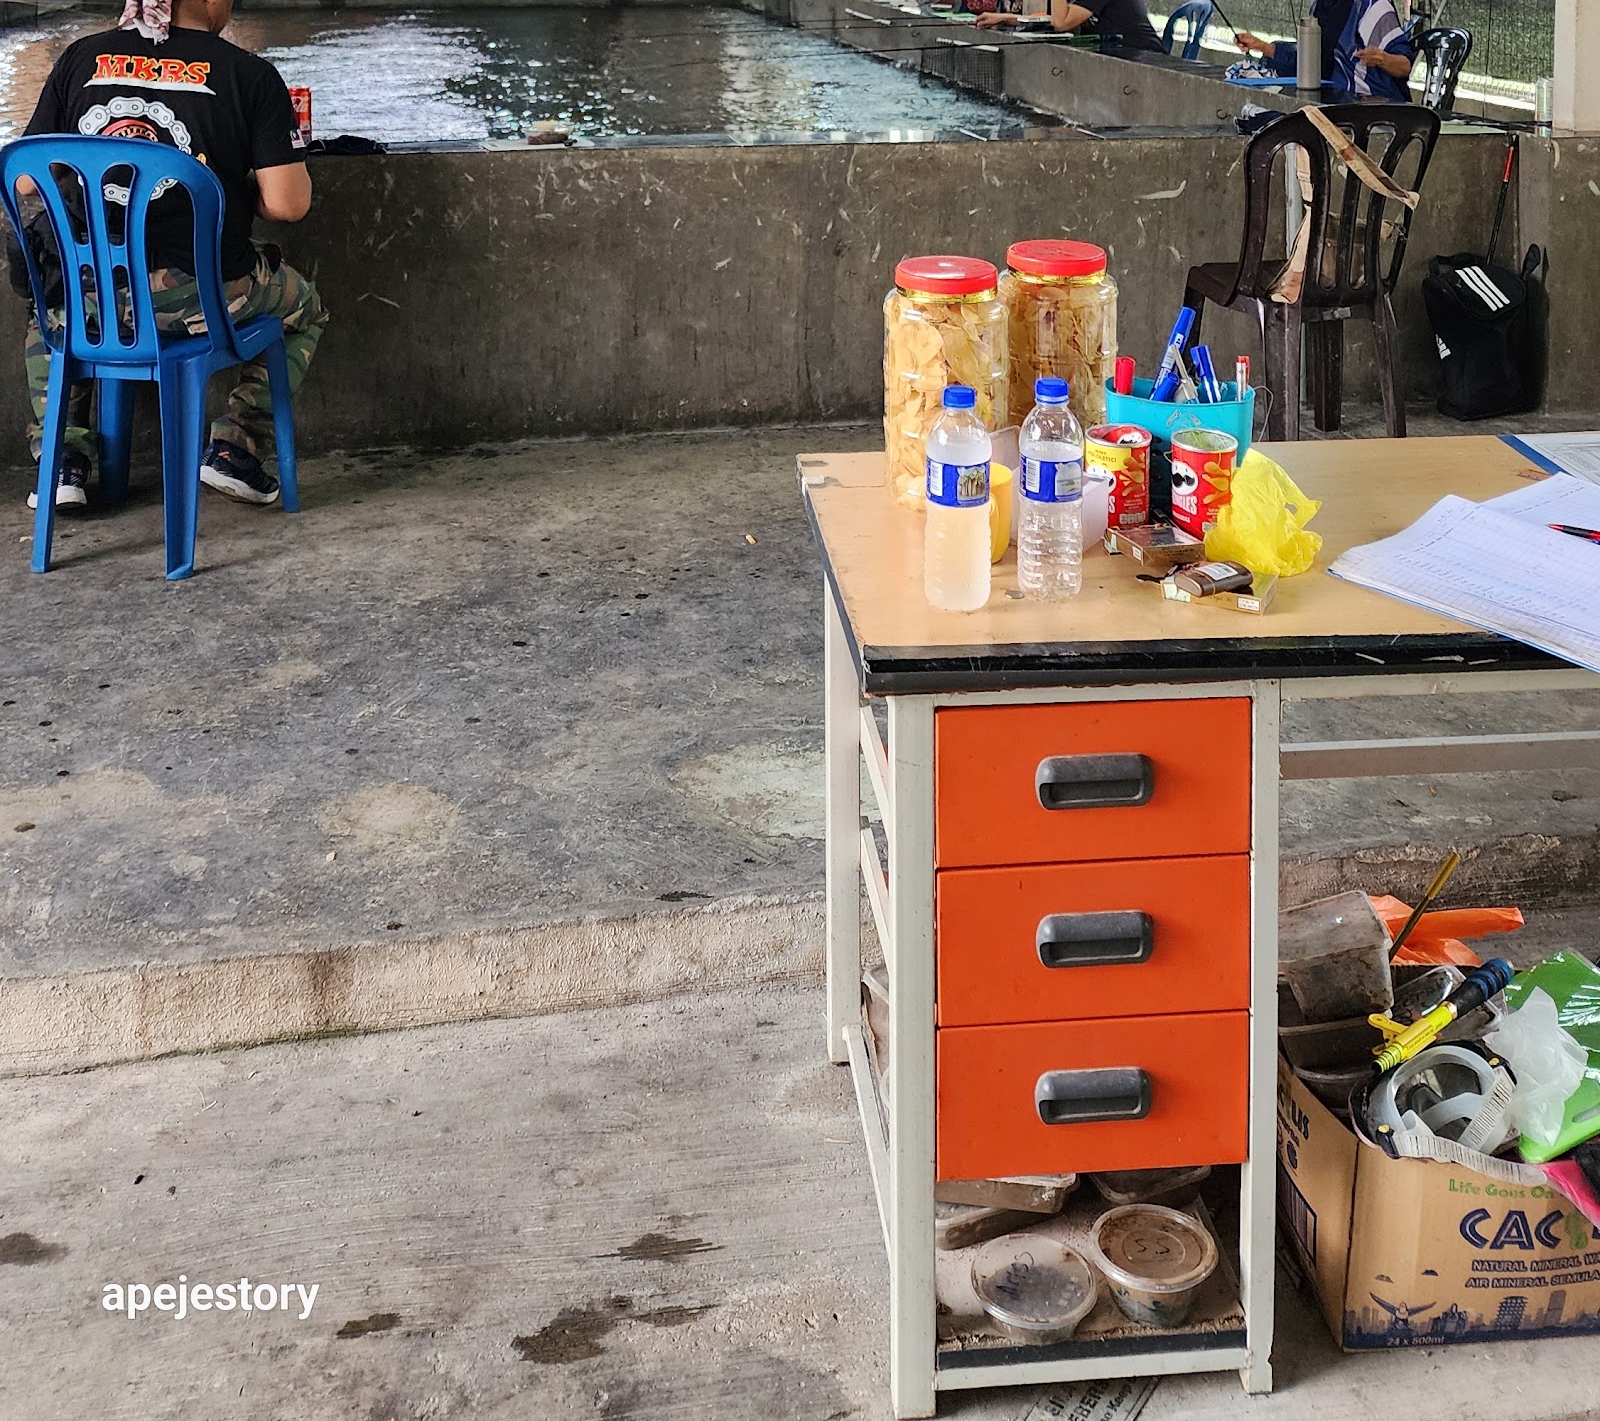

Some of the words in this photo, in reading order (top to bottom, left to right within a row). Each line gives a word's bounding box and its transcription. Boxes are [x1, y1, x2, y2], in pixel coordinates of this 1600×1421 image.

[92, 54, 210, 85] MKRS
[1449, 1178, 1480, 1195] Life
[1530, 1186, 1554, 1198] On
[1472, 1260, 1527, 1272] NATURAL
[1530, 1255, 1582, 1271] MINERAL
[1465, 1277, 1492, 1288] AIR
[1492, 1276, 1549, 1288] MINERAL
